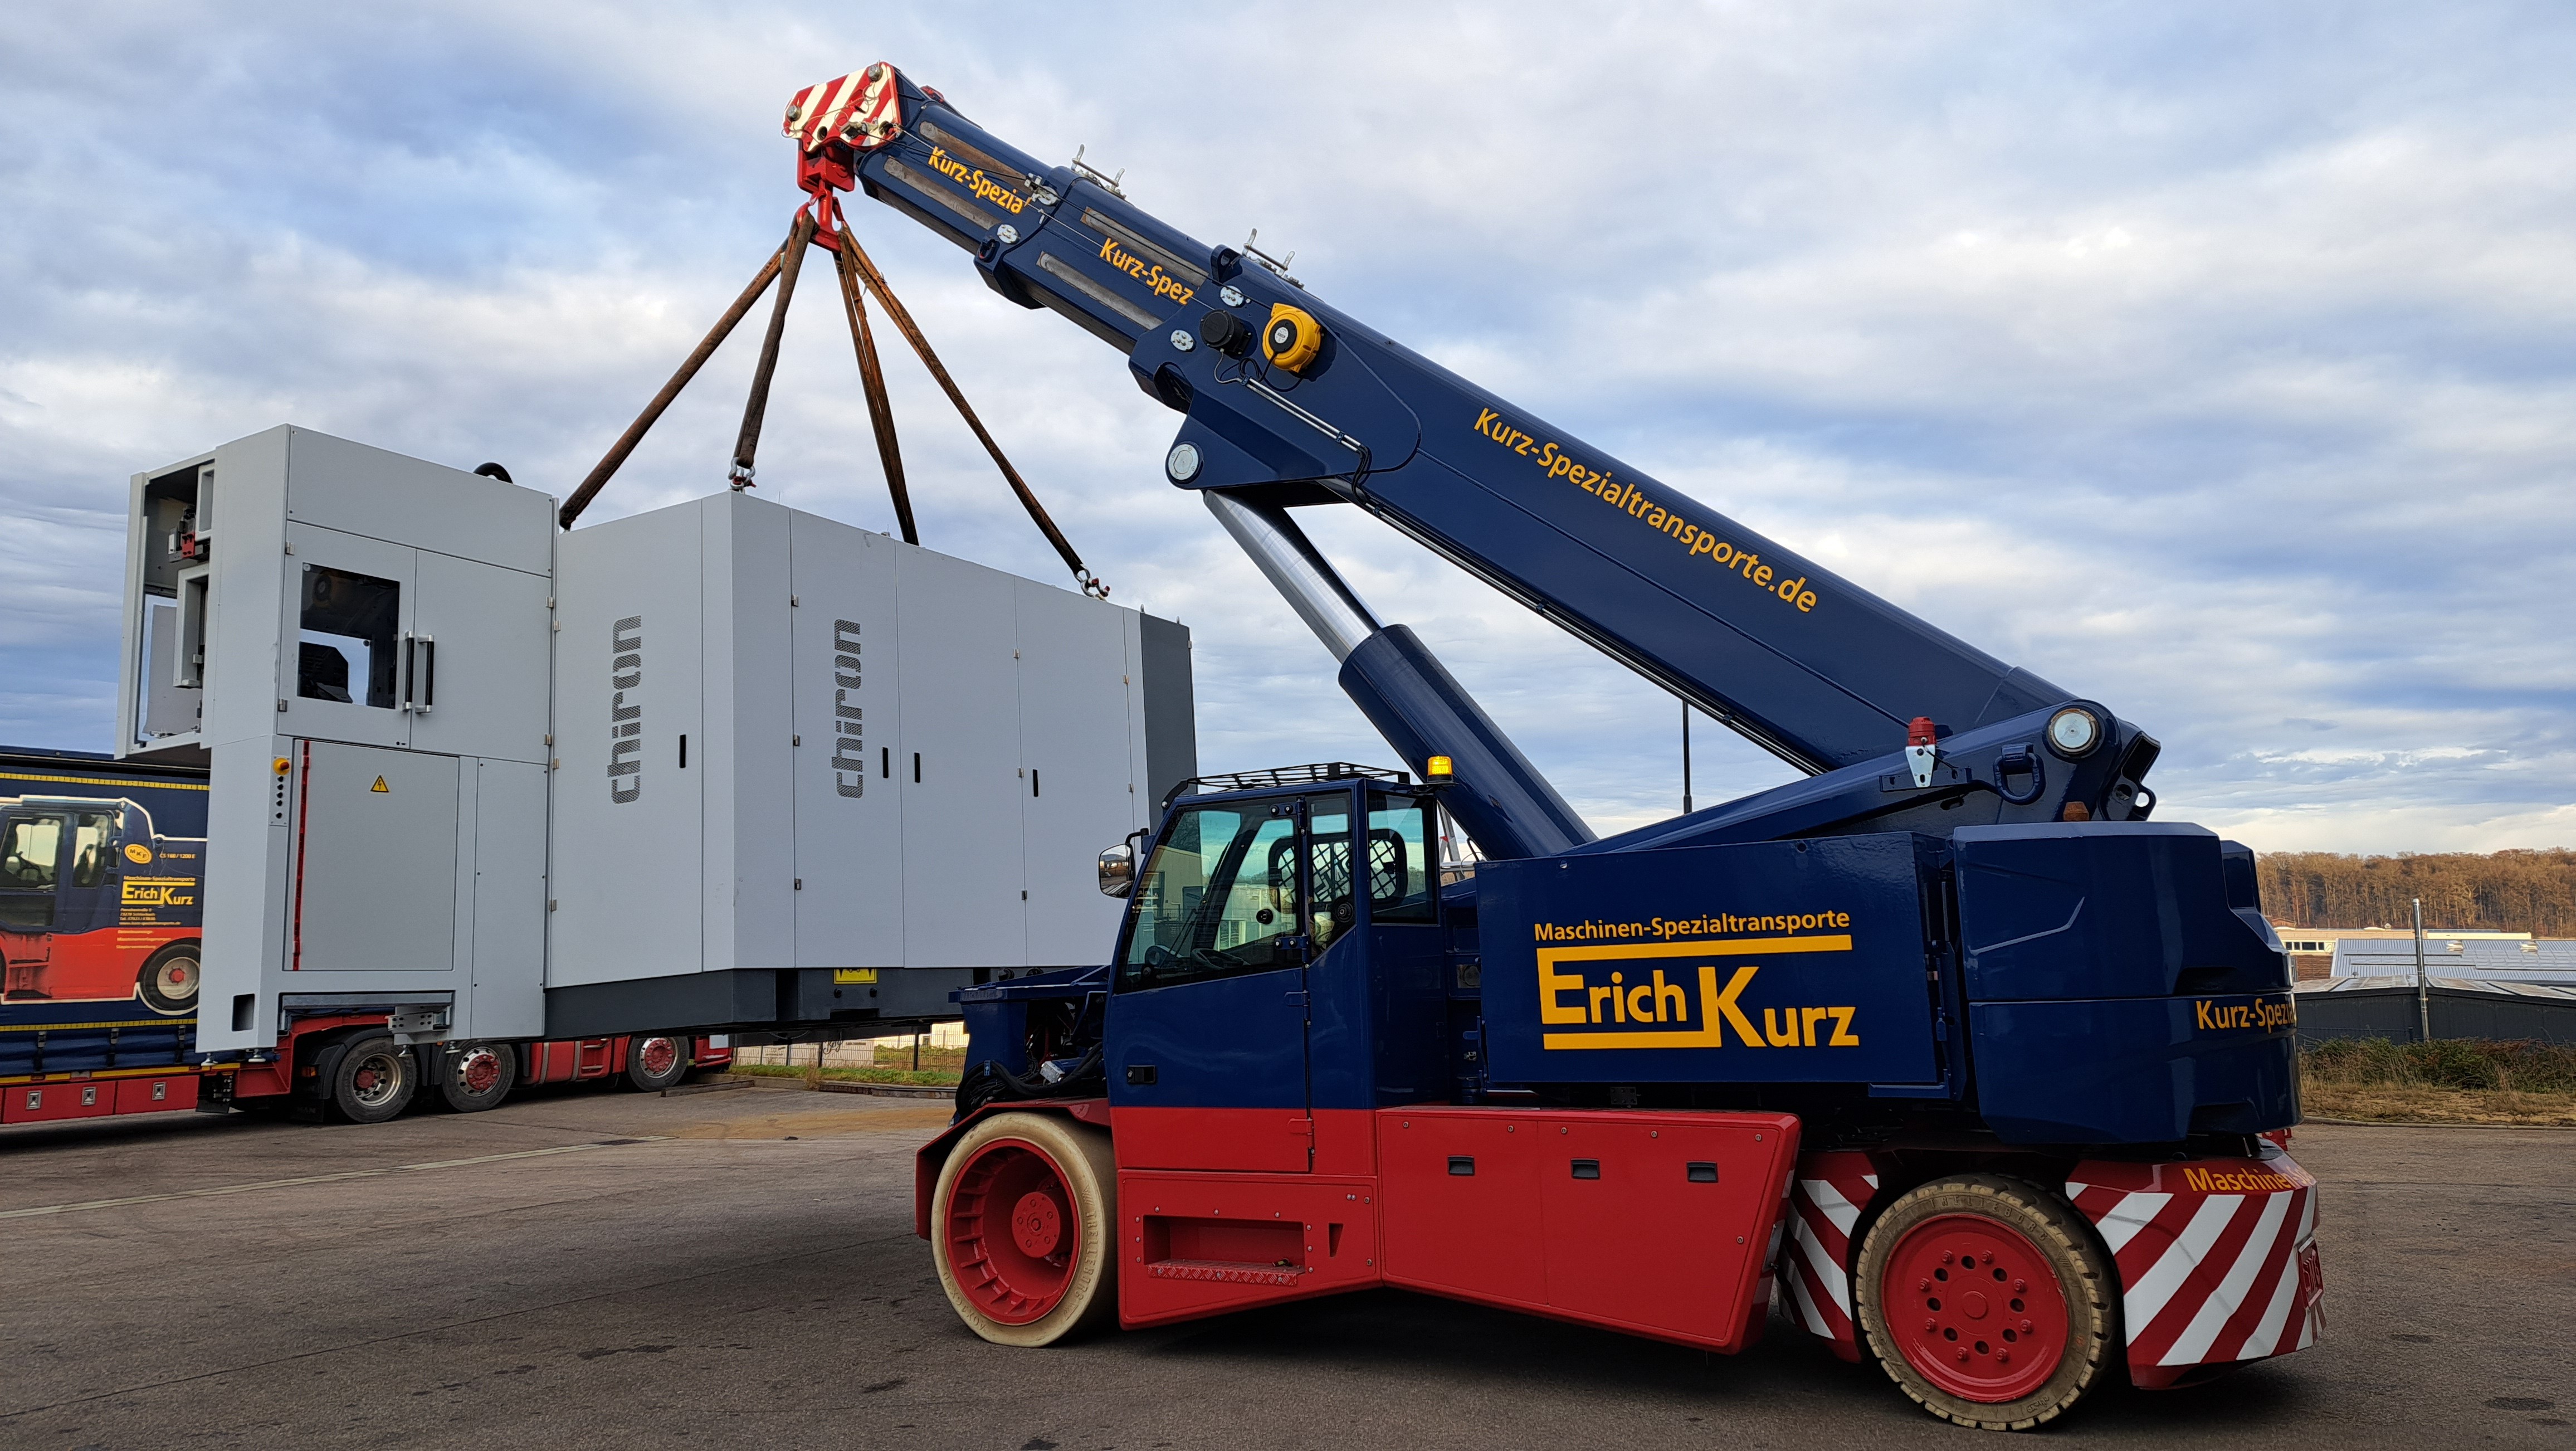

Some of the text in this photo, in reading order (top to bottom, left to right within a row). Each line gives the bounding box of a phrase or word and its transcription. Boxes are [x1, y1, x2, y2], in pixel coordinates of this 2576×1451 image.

[1100, 237, 1194, 305] Kurz-Spez
[1474, 407, 1817, 612] Kurz-Spezialtransporte.de
[607, 615, 641, 804] chiron
[831, 619, 863, 798] chiron
[121, 881, 194, 905] Erich Kurz
[1534, 910, 1851, 942] Maschinen-Spezialtransporte
[1536, 947, 1860, 1048] Erich Kurz
[1075, 1210, 1099, 1301] TRELLEBORG
[1930, 1196, 2048, 1241] TRELLEBORG
